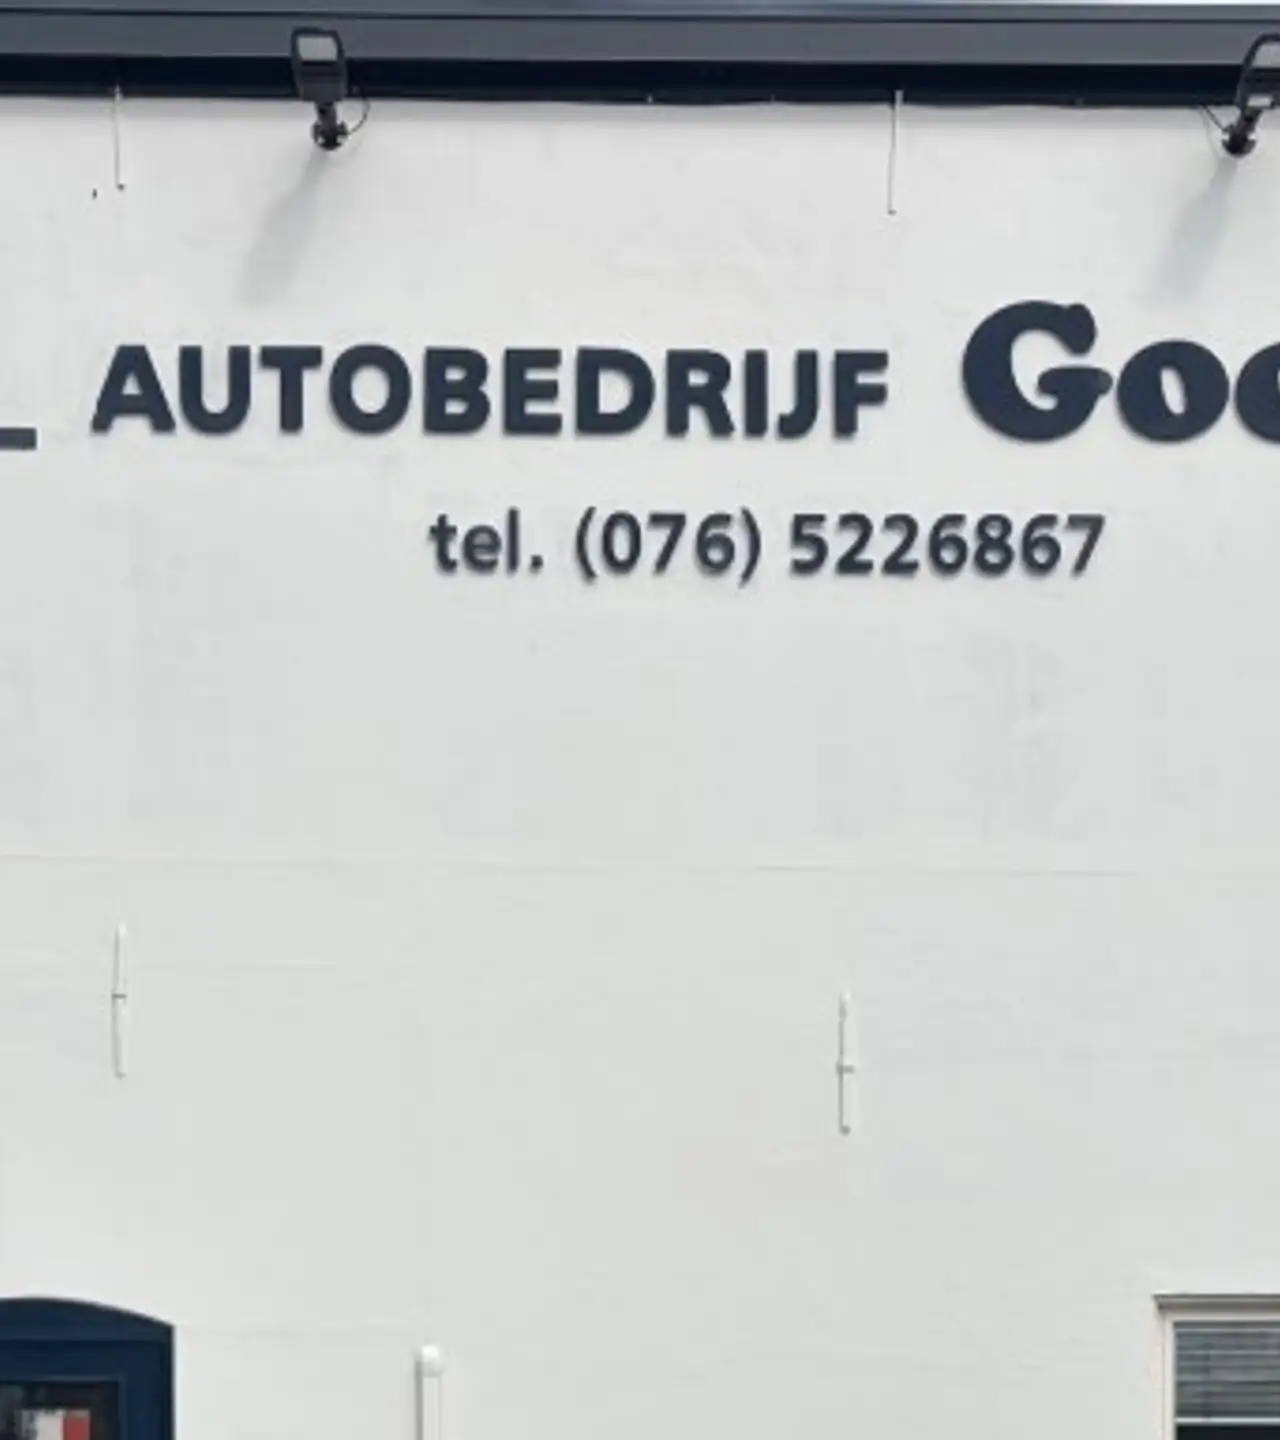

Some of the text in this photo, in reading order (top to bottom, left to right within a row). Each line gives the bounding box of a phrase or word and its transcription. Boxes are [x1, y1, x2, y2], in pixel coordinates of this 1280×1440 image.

[91, 344, 888, 438] AUTOBEDRIJF
[429, 506, 1104, 583] tel. (076) 5226867
